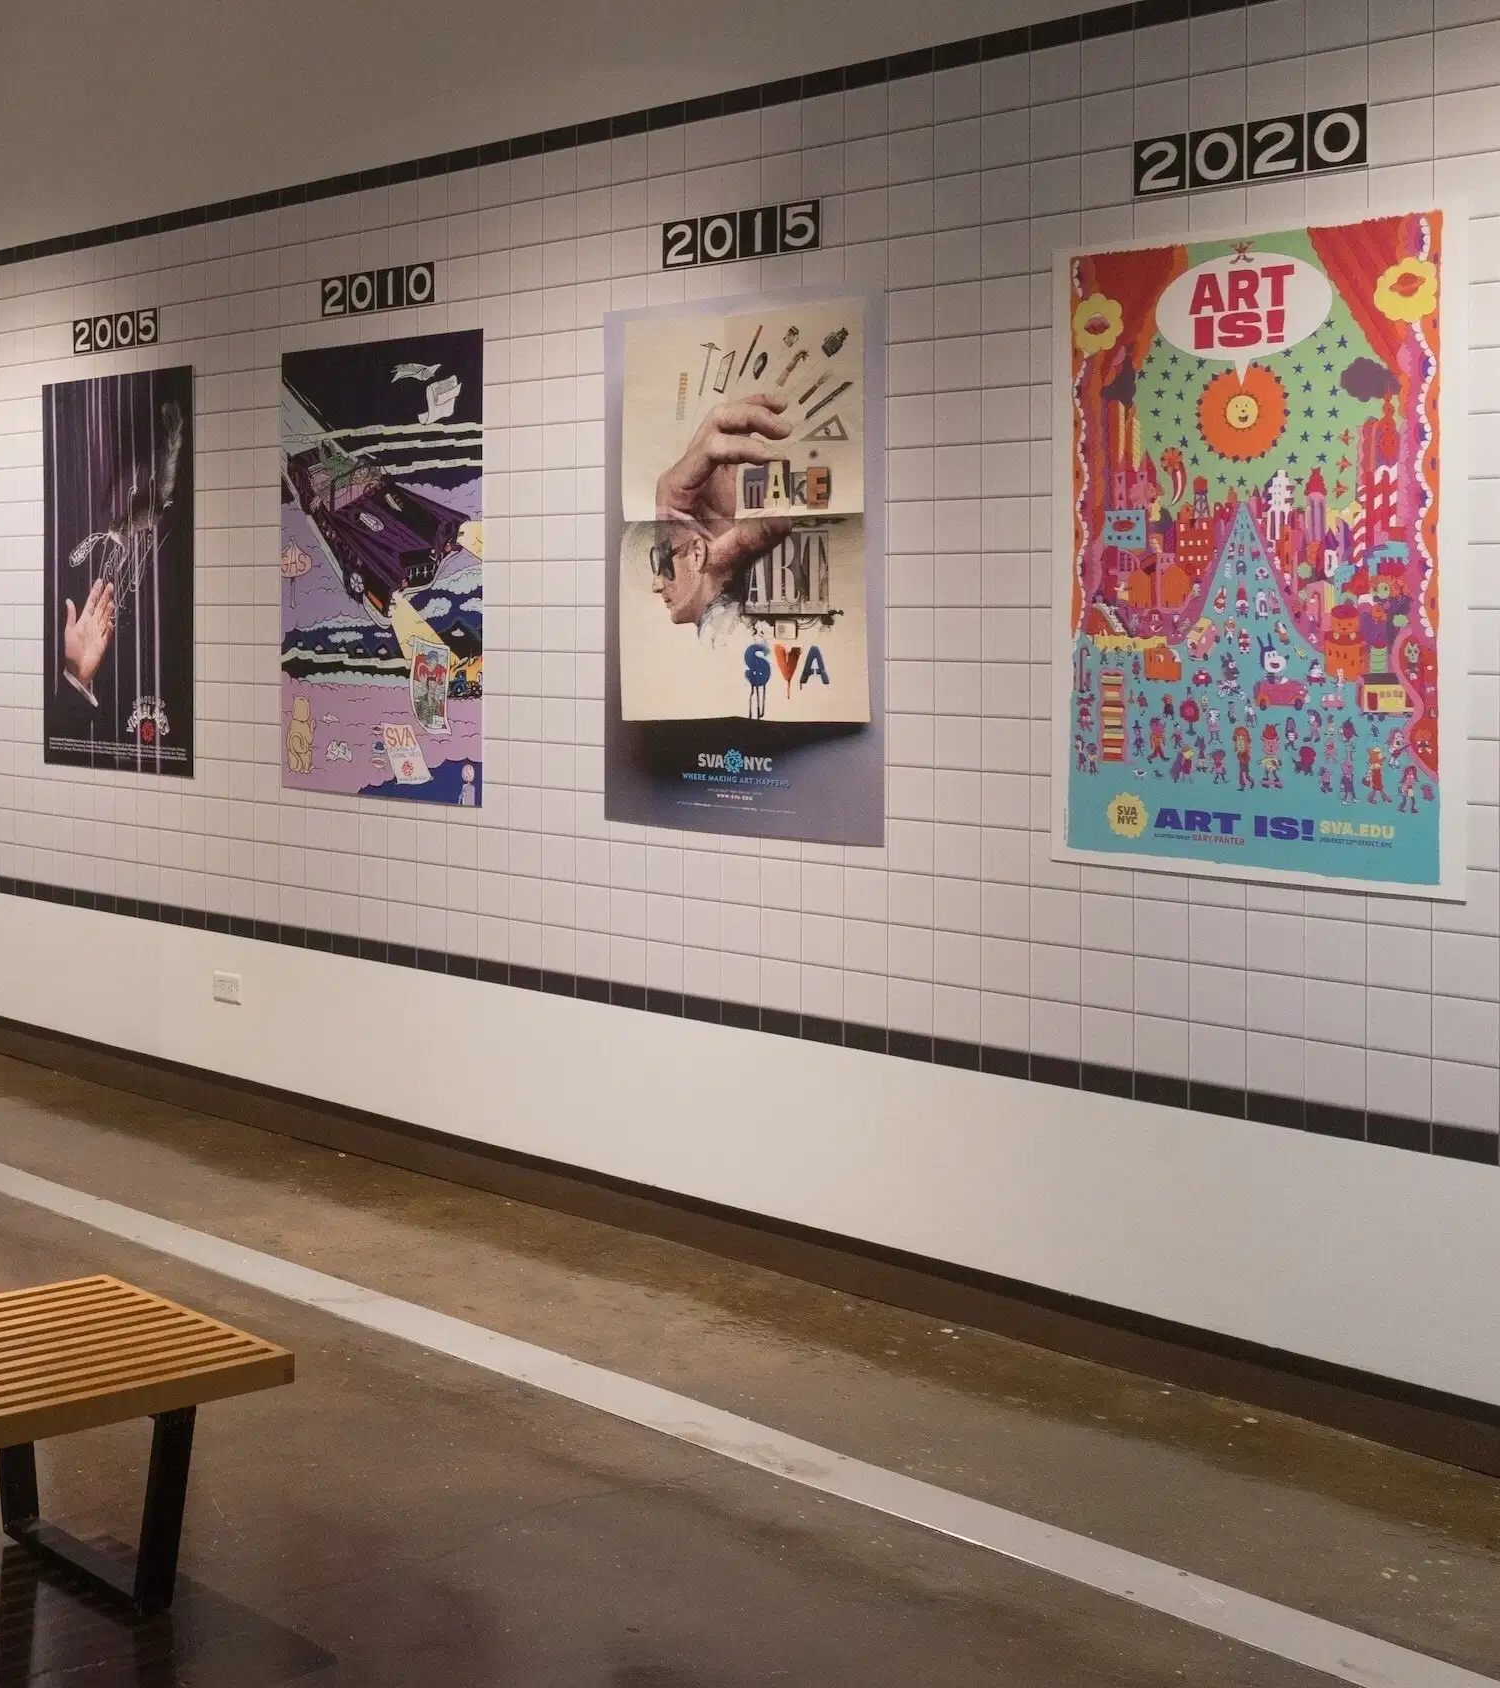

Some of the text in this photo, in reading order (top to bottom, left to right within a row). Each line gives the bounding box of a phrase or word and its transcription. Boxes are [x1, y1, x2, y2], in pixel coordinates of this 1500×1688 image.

[1139, 112, 1360, 192] 2020
[666, 204, 815, 265] 2015
[323, 266, 432, 314] 2010
[1188, 264, 1295, 315] ART
[74, 310, 156, 352] 2005
[1194, 308, 1285, 350] IS!
[281, 553, 307, 573] GAS
[747, 531, 829, 605] ART
[745, 644, 830, 692] SVA
[385, 726, 417, 747] SVA
[682, 772, 707, 781] WHERE
[708, 775, 737, 783] MAKING
[756, 779, 791, 788] HAPPENS
[697, 753, 773, 772] SVA NYC
[1116, 805, 1138, 817] SVA
[1116, 815, 1139, 826] NYC
[1154, 807, 1315, 842] ART IS!
[1192, 833, 1213, 842] GARY
[1214, 835, 1245, 846] PANTER
[1319, 820, 1395, 839] SVA.EDU
